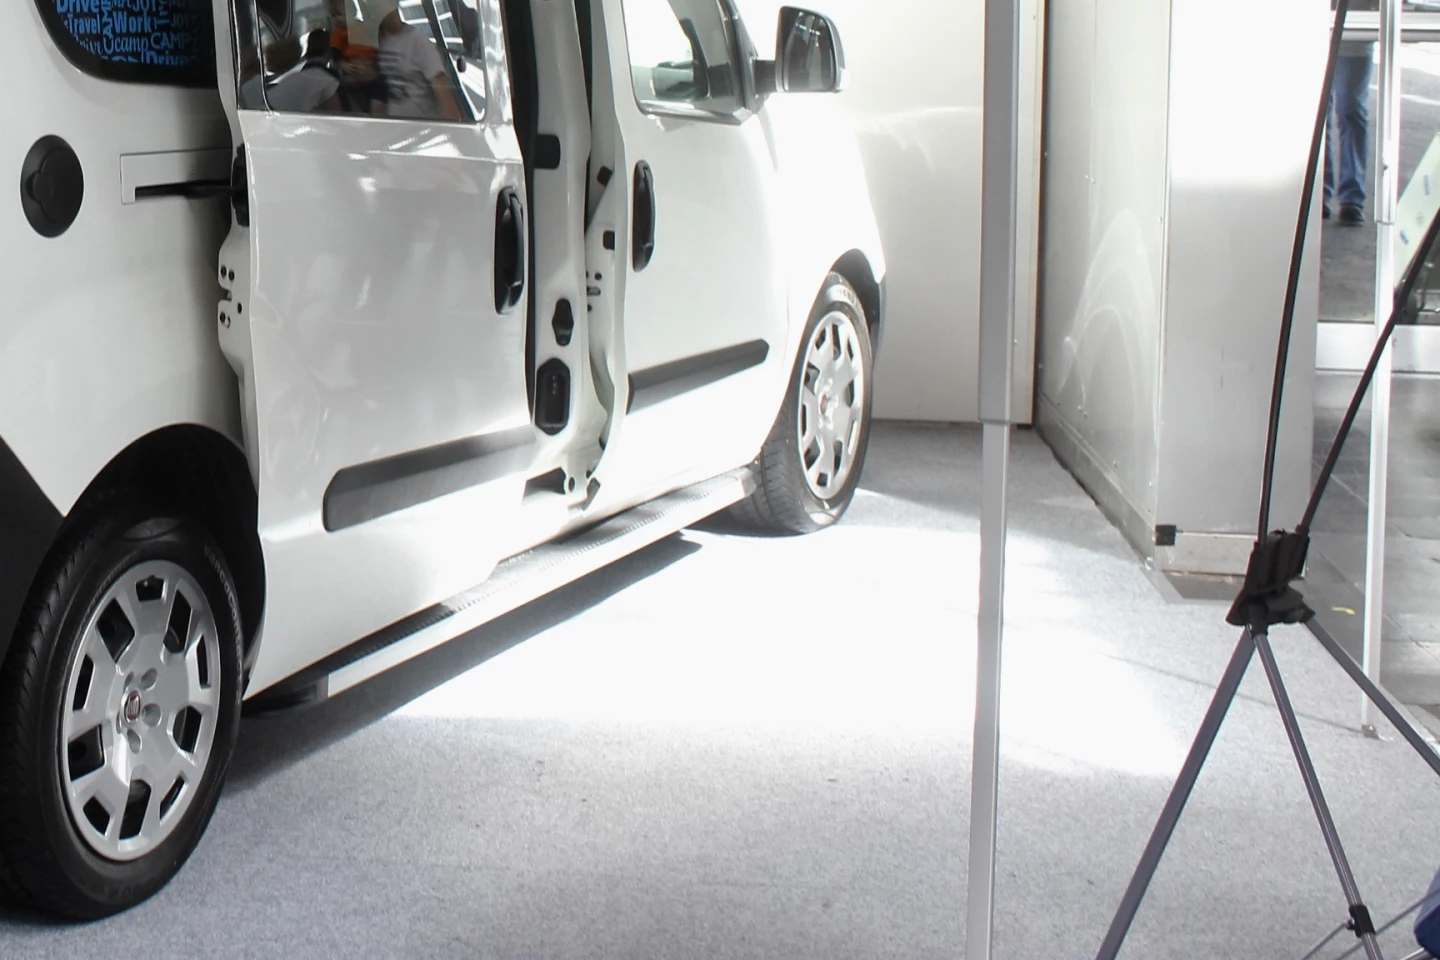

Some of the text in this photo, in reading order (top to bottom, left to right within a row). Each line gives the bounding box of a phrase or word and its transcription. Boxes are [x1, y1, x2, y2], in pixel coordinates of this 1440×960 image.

[66, 12, 101, 34] Travel
[112, 10, 153, 33] Work
[114, 35, 149, 64] camp
